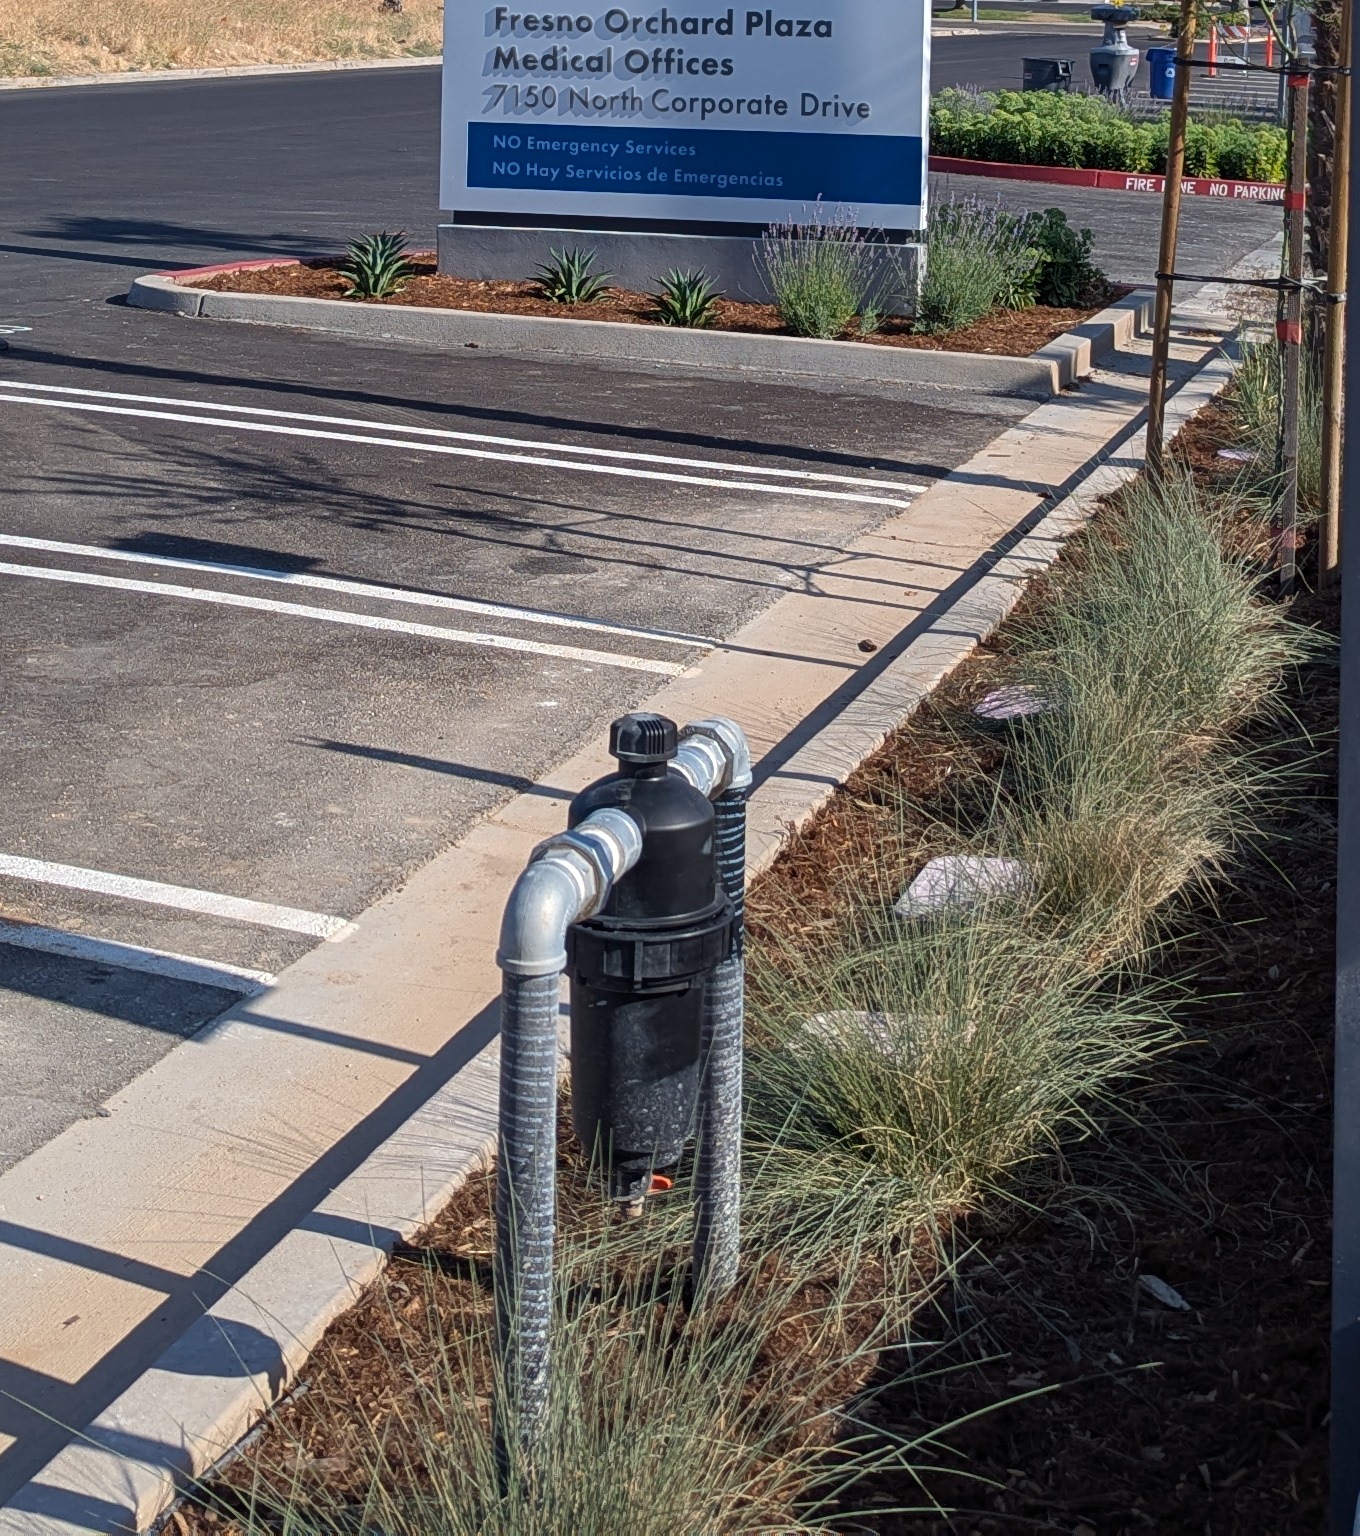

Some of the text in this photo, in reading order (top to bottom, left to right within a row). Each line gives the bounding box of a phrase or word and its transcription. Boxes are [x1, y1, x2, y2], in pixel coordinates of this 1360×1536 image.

[493, 6, 834, 38] Fresno Orchard Plaza
[493, 45, 735, 76] Medical Offices
[492, 84, 872, 121] 7150 North Corporate Drive
[493, 135, 697, 157] NO Emergency Services
[492, 161, 784, 190] NO Hay Servicios de Emergencias
[1125, 177, 1156, 192] FIRE
[1161, 180, 1197, 195] LNE
[1209, 182, 1228, 197] NO
